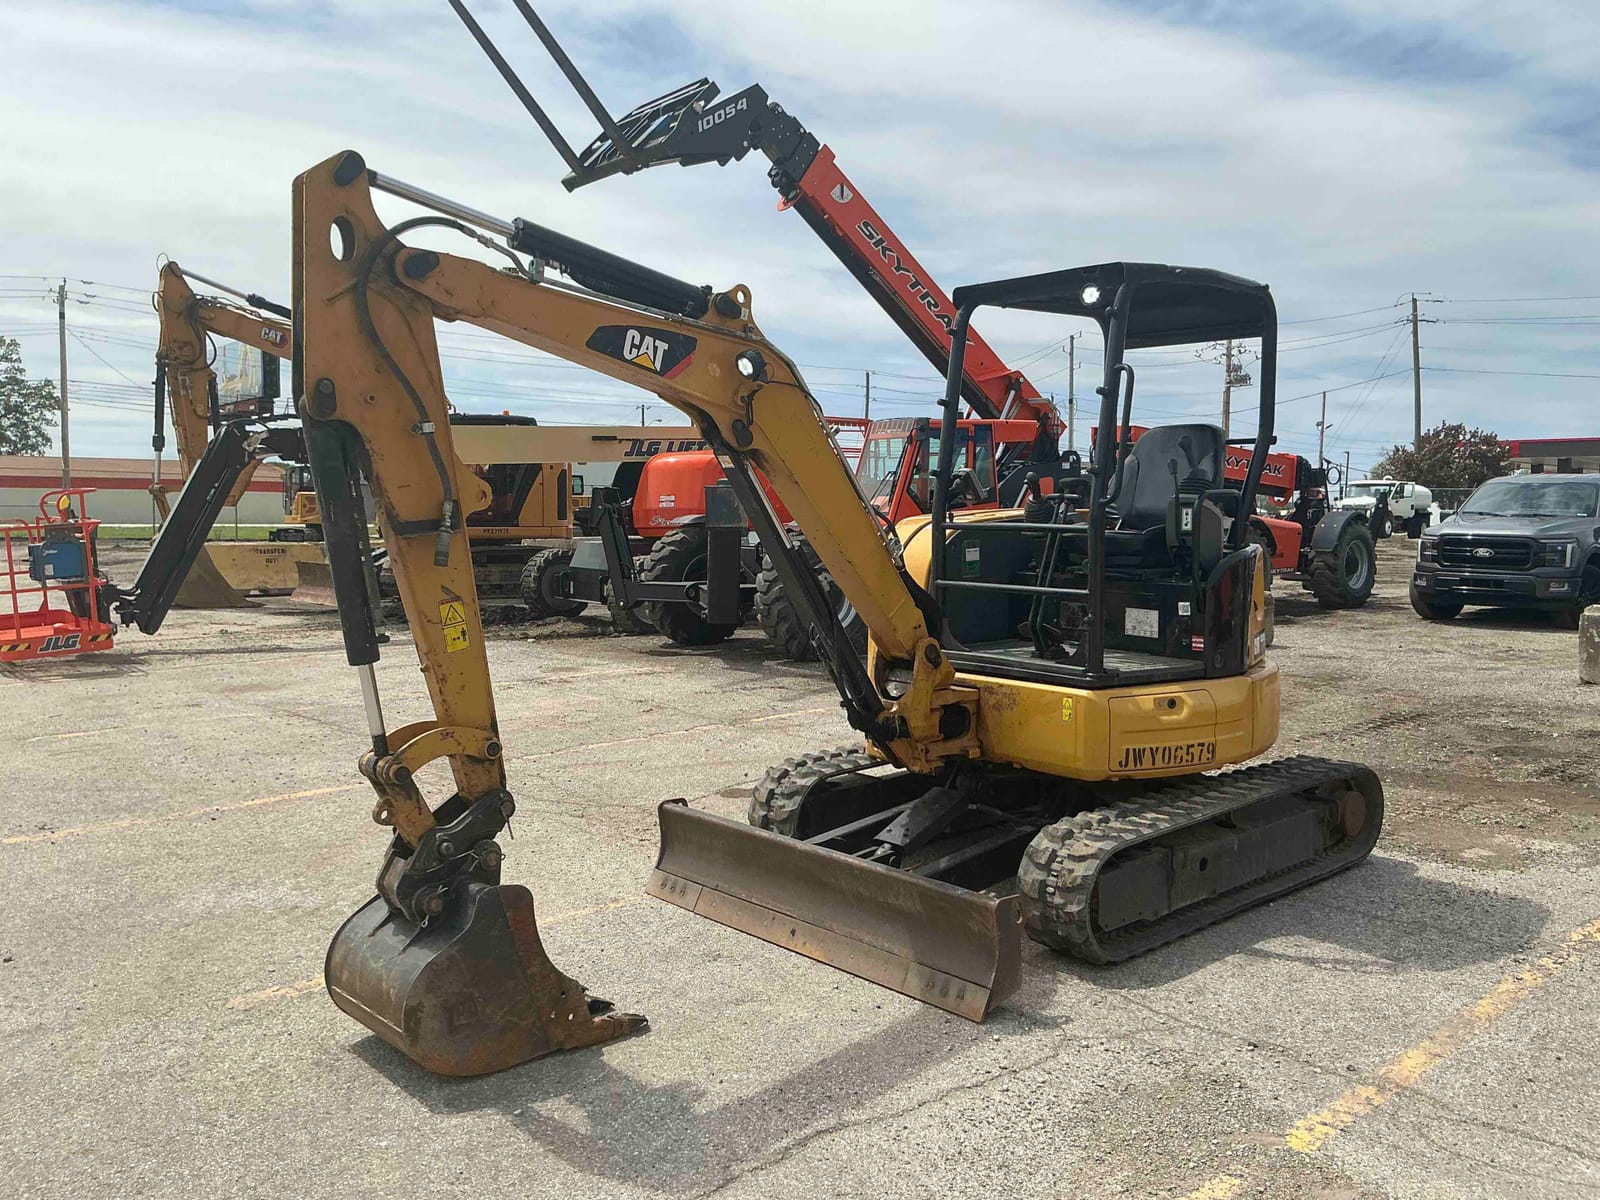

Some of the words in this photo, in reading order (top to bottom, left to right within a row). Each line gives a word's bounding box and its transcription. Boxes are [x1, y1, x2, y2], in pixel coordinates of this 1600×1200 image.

[697, 97, 748, 133] 10054
[855, 219, 975, 346] SKYTRA
[261, 327, 283, 345] CAT
[623, 329, 669, 371] CAT
[624, 439, 661, 456] JLG
[38, 633, 81, 654] JLG
[1118, 742, 1215, 769] JWY06579
